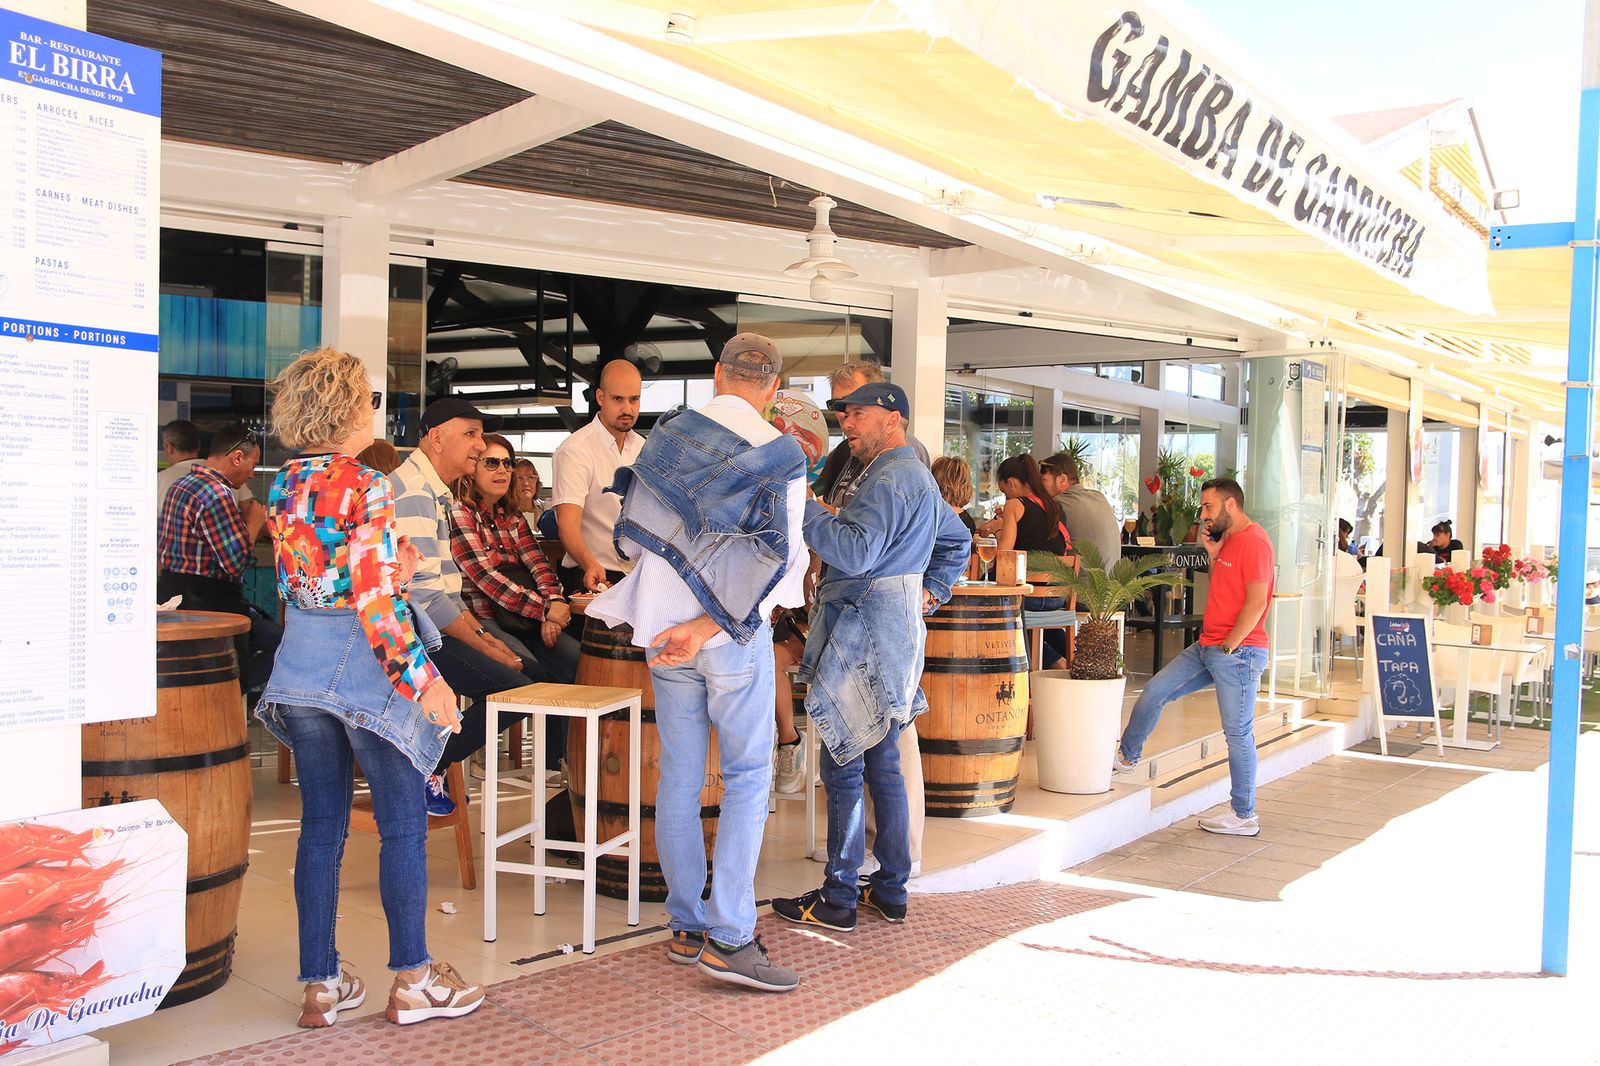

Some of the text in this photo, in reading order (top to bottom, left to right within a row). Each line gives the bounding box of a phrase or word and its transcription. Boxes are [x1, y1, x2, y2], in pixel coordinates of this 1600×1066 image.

[20, 31, 42, 45] BAR
[50, 40, 122, 67] RESTAURANTE
[8, 40, 136, 95] EL BIRRA
[32, 74, 79, 92] GARRUCHA
[80, 85, 106, 99] DESDE
[107, 93, 124, 103] 1978
[37, 102, 115, 128] ARROCES RICES
[1087, 11, 1252, 180] GAMBA
[1242, 114, 1305, 207] DE
[36, 188, 139, 215] CARNES MEAT DISHES
[35, 256, 69, 270] PASTAS
[3, 321, 59, 337] PORTIONS
[73, 330, 126, 345] PORTIONS
[985, 640, 1016, 649] VETIVE
[1377, 631, 1417, 647] CAÑA
[1379, 660, 1419, 674] TAPA
[26, 1008, 60, 1032] De
[67, 981, 163, 1025] Garrucha
